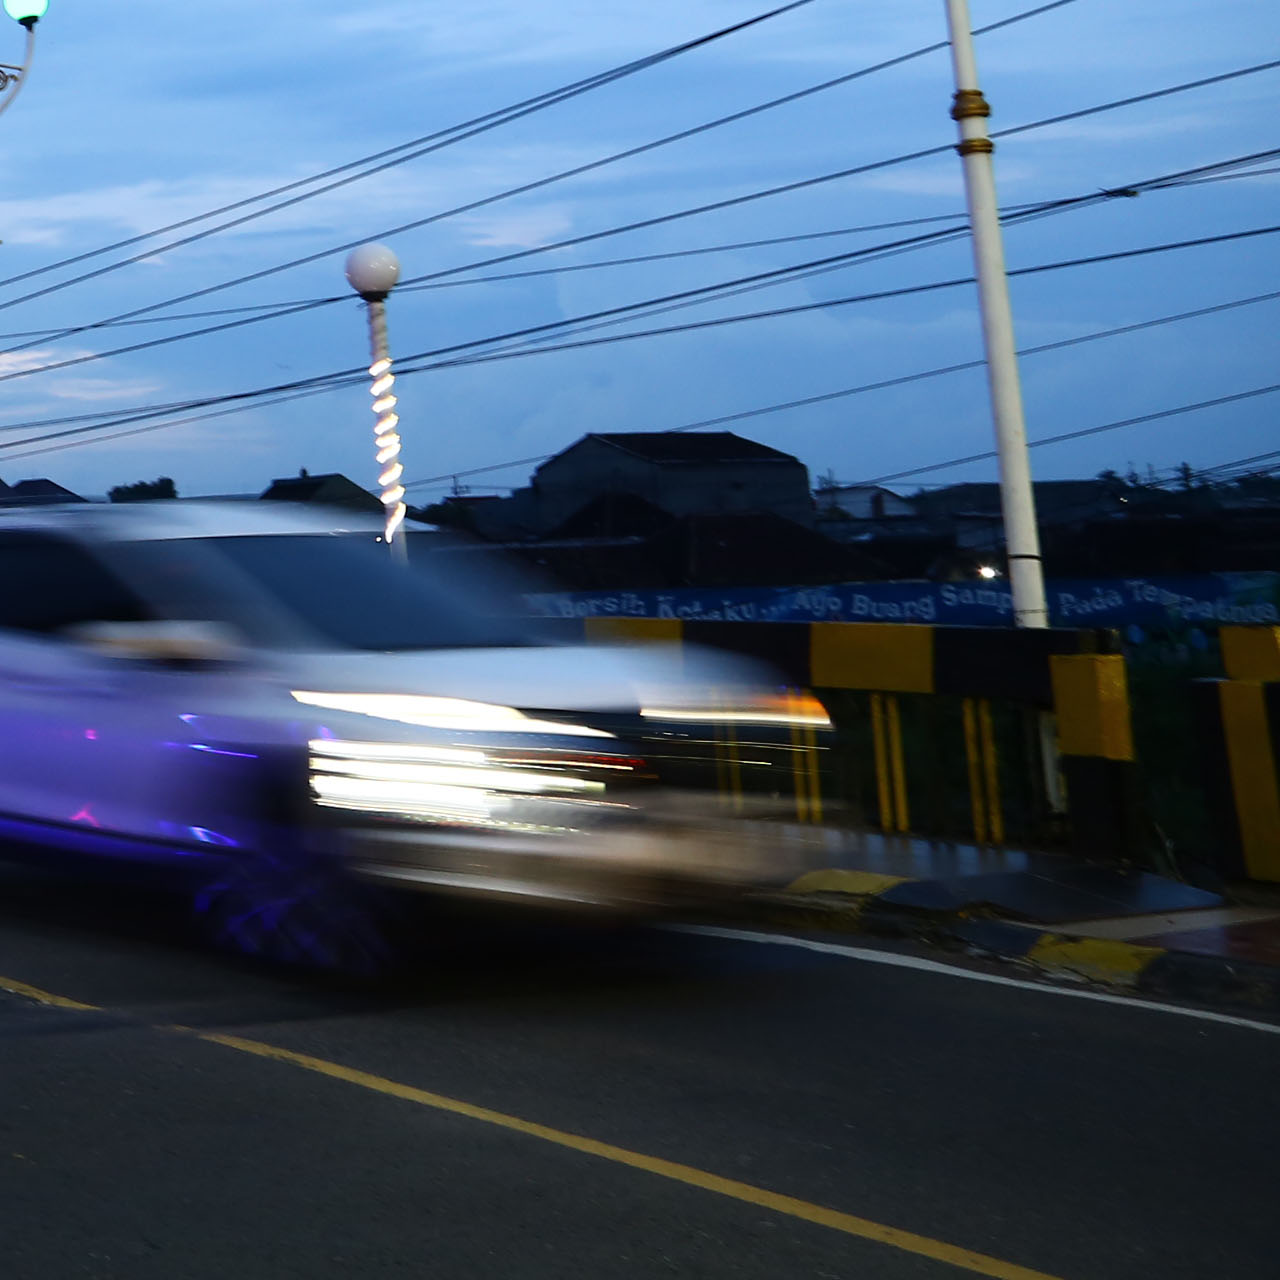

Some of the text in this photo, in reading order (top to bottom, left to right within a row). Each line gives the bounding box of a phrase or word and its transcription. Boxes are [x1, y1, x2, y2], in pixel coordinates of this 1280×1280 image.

[791, 590, 842, 617] Ayo
[851, 592, 937, 620] Buang
[941, 584, 1013, 615] Samp
[1057, 586, 1126, 617] Pada
